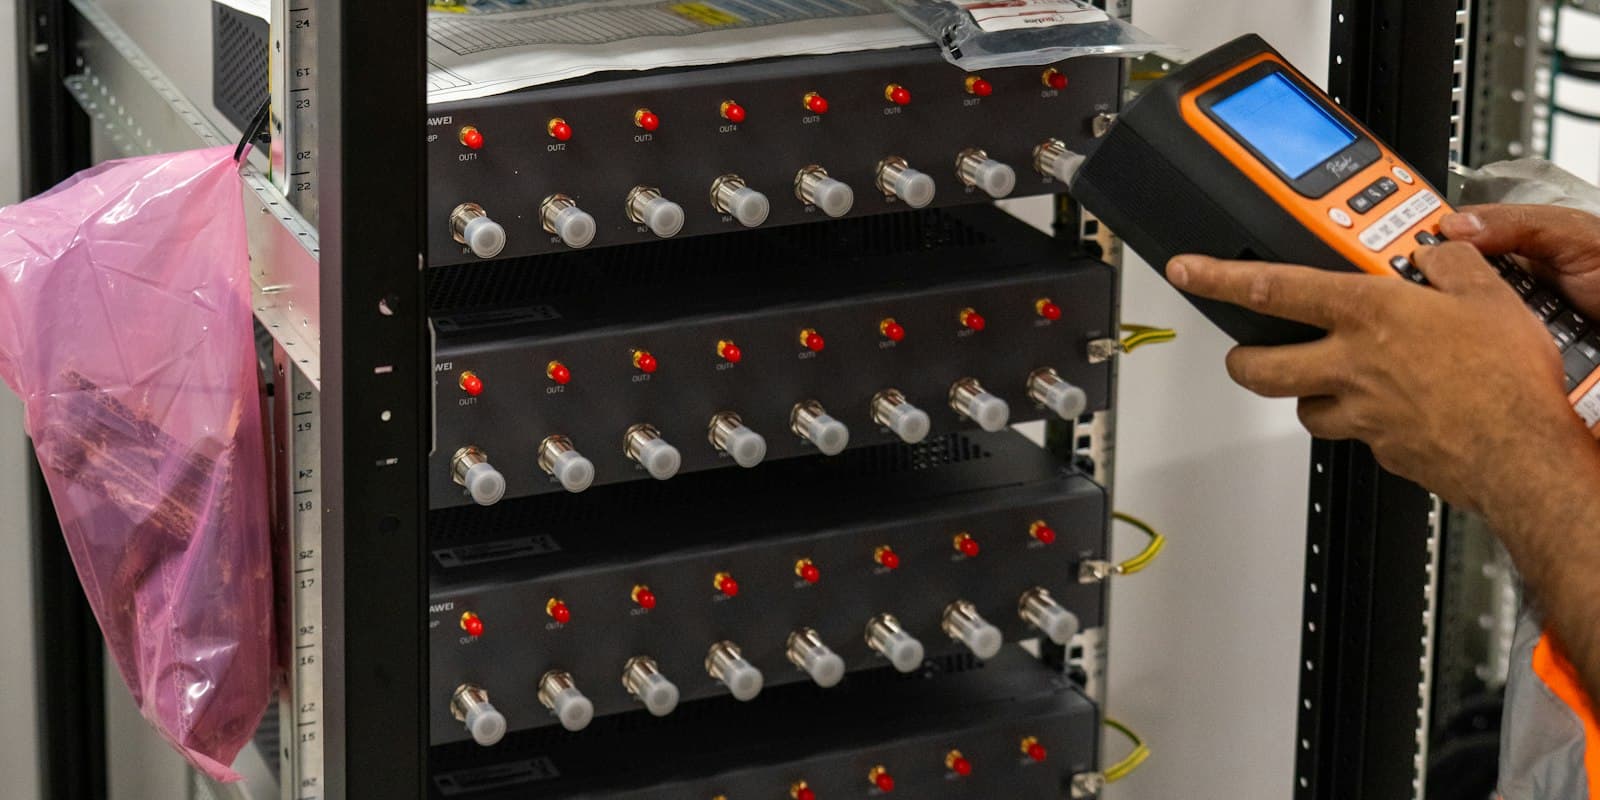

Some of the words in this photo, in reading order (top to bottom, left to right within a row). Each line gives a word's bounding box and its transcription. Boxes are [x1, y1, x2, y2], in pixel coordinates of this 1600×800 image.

[295, 19, 309, 28] 24
[296, 67, 310, 77] 19
[295, 99, 310, 109] 23
[719, 124, 736, 133] OUT4
[634, 134, 652, 142] OUT3
[547, 143, 565, 151] OUT2
[296, 151, 311, 160] 20
[458, 153, 477, 161] OUT1
[296, 182, 311, 191] 22
[546, 385, 564, 394] OUT2
[458, 398, 477, 406] OUT1
[297, 422, 311, 432] 19
[298, 501, 312, 512] 18
[300, 578, 314, 588] 17
[301, 655, 314, 665] 16
[302, 732, 315, 742] 15
